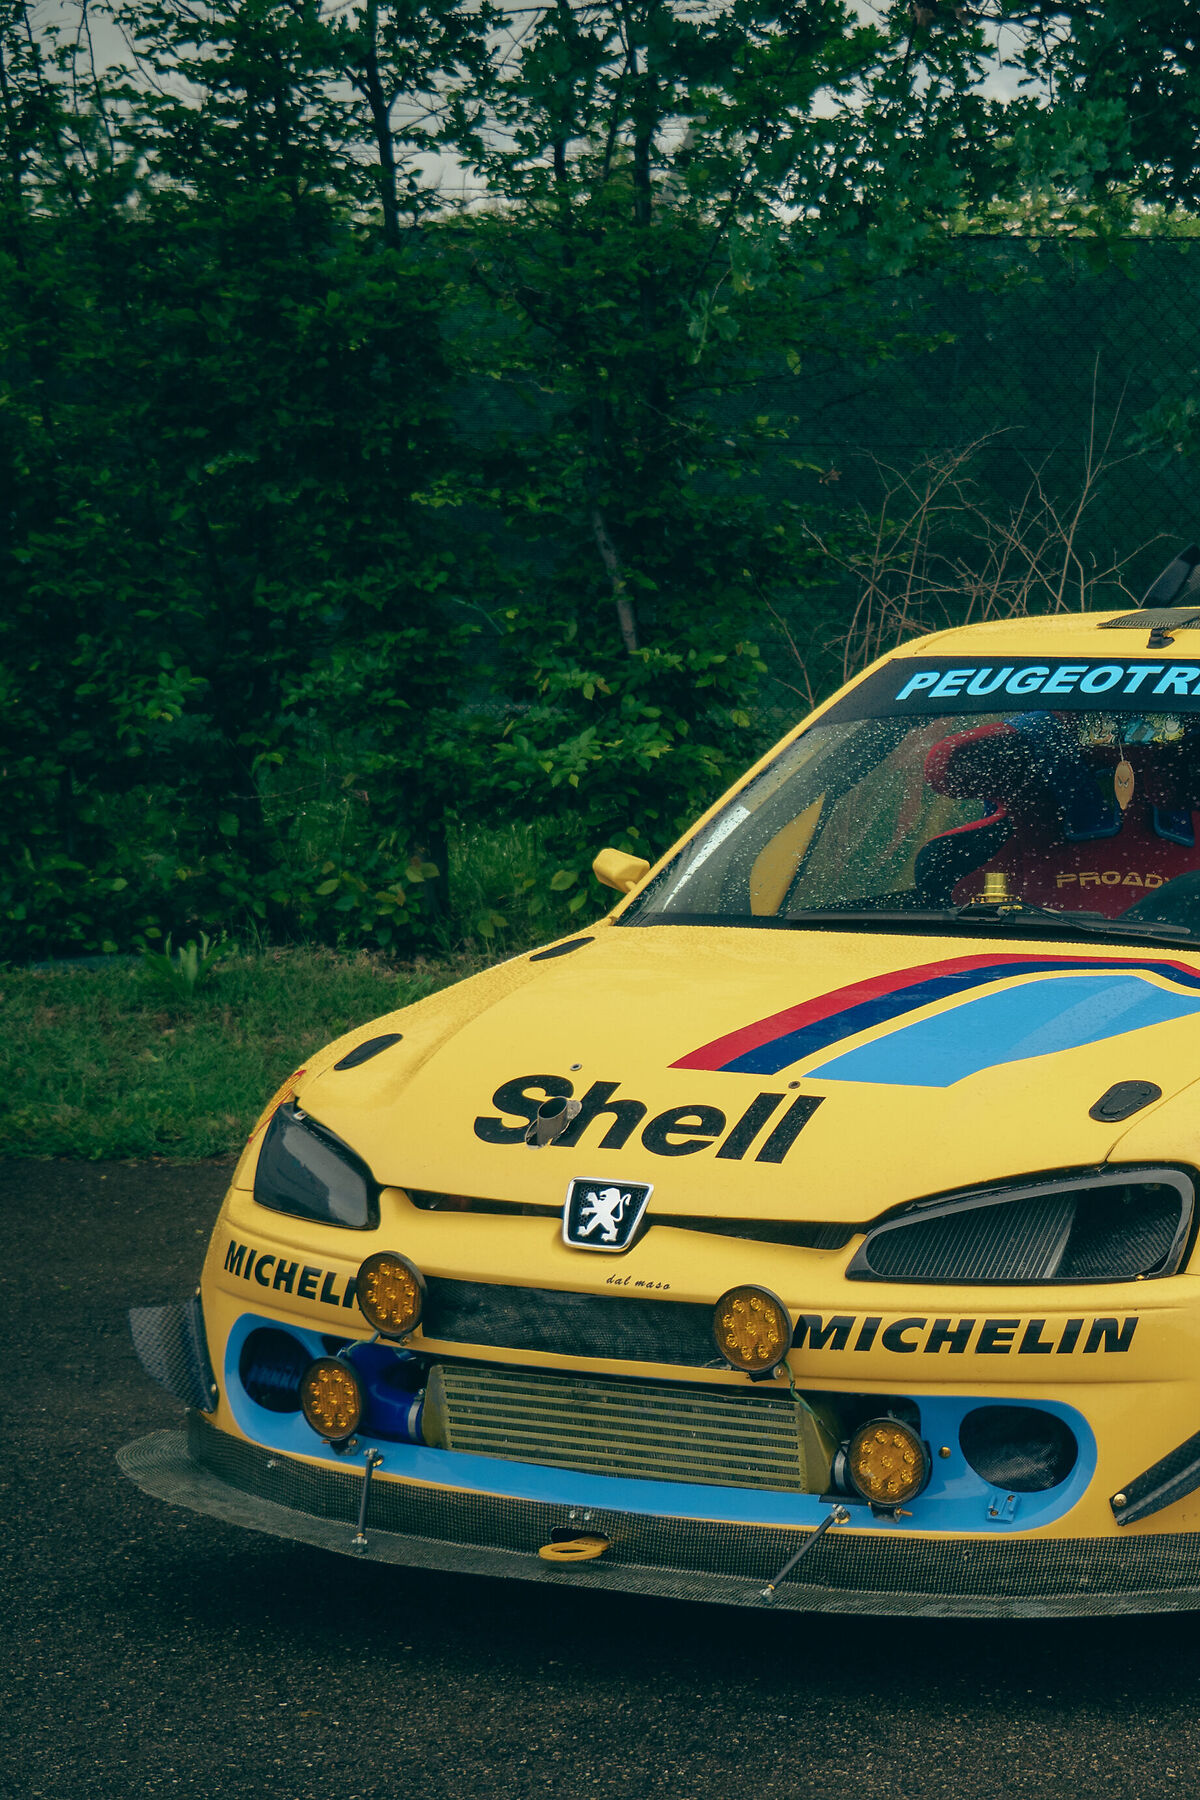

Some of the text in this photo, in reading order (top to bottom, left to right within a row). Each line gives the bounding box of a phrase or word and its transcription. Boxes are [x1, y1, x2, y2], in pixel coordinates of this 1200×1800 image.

[1056, 871, 1169, 889] PROAD
[473, 1074, 827, 1164] Shell
[224, 1239, 361, 1311] MICHELI
[606, 1273, 671, 1290] dal maso
[790, 1314, 1139, 1354] MICHELIN
